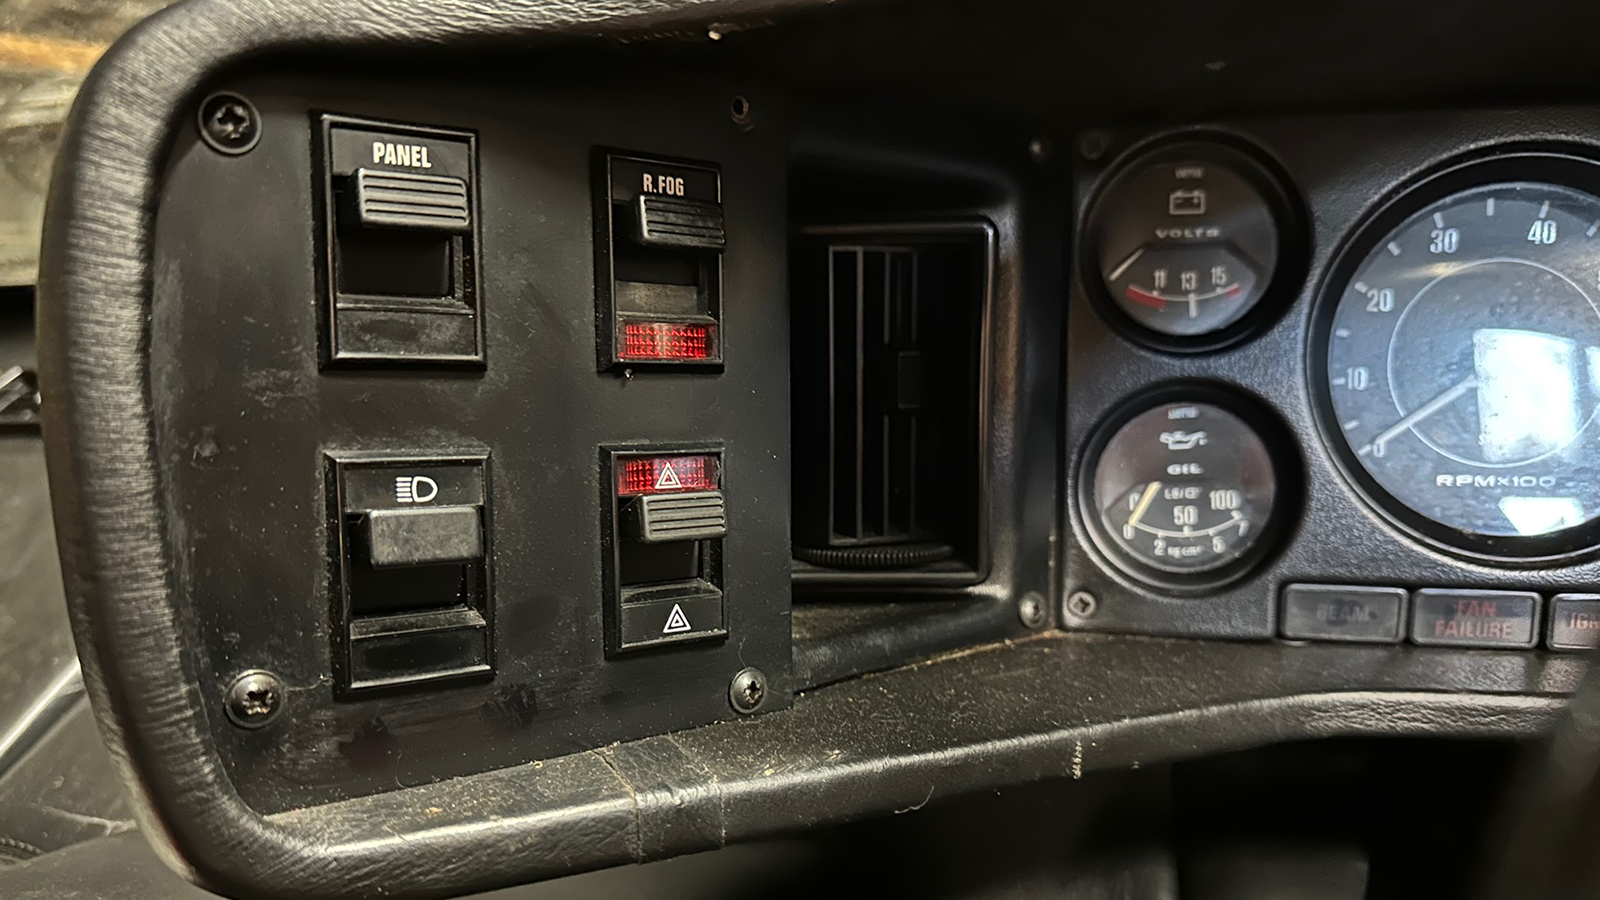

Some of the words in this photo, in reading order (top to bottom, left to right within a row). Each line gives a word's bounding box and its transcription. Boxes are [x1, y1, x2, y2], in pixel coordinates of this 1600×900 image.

[373, 141, 432, 168] PANEL
[642, 173, 685, 197] R.FOG
[1155, 227, 1222, 239] VOLTS
[1429, 228, 1459, 254] 30
[1527, 219, 1558, 245] 40
[1153, 268, 1167, 289] 11
[1180, 270, 1197, 291] 13
[1211, 265, 1228, 286] 15
[1365, 288, 1395, 313] 20
[1346, 366, 1368, 391] 10
[1167, 463, 1204, 476] OIL
[1173, 505, 1198, 526] 50
[1209, 490, 1241, 511] 100
[1123, 524, 1135, 540] 0
[1154, 538, 1166, 556] 2
[1316, 603, 1370, 622] BEAM
[1457, 600, 1497, 617] FAN
[1434, 620, 1512, 639] FAILURE
